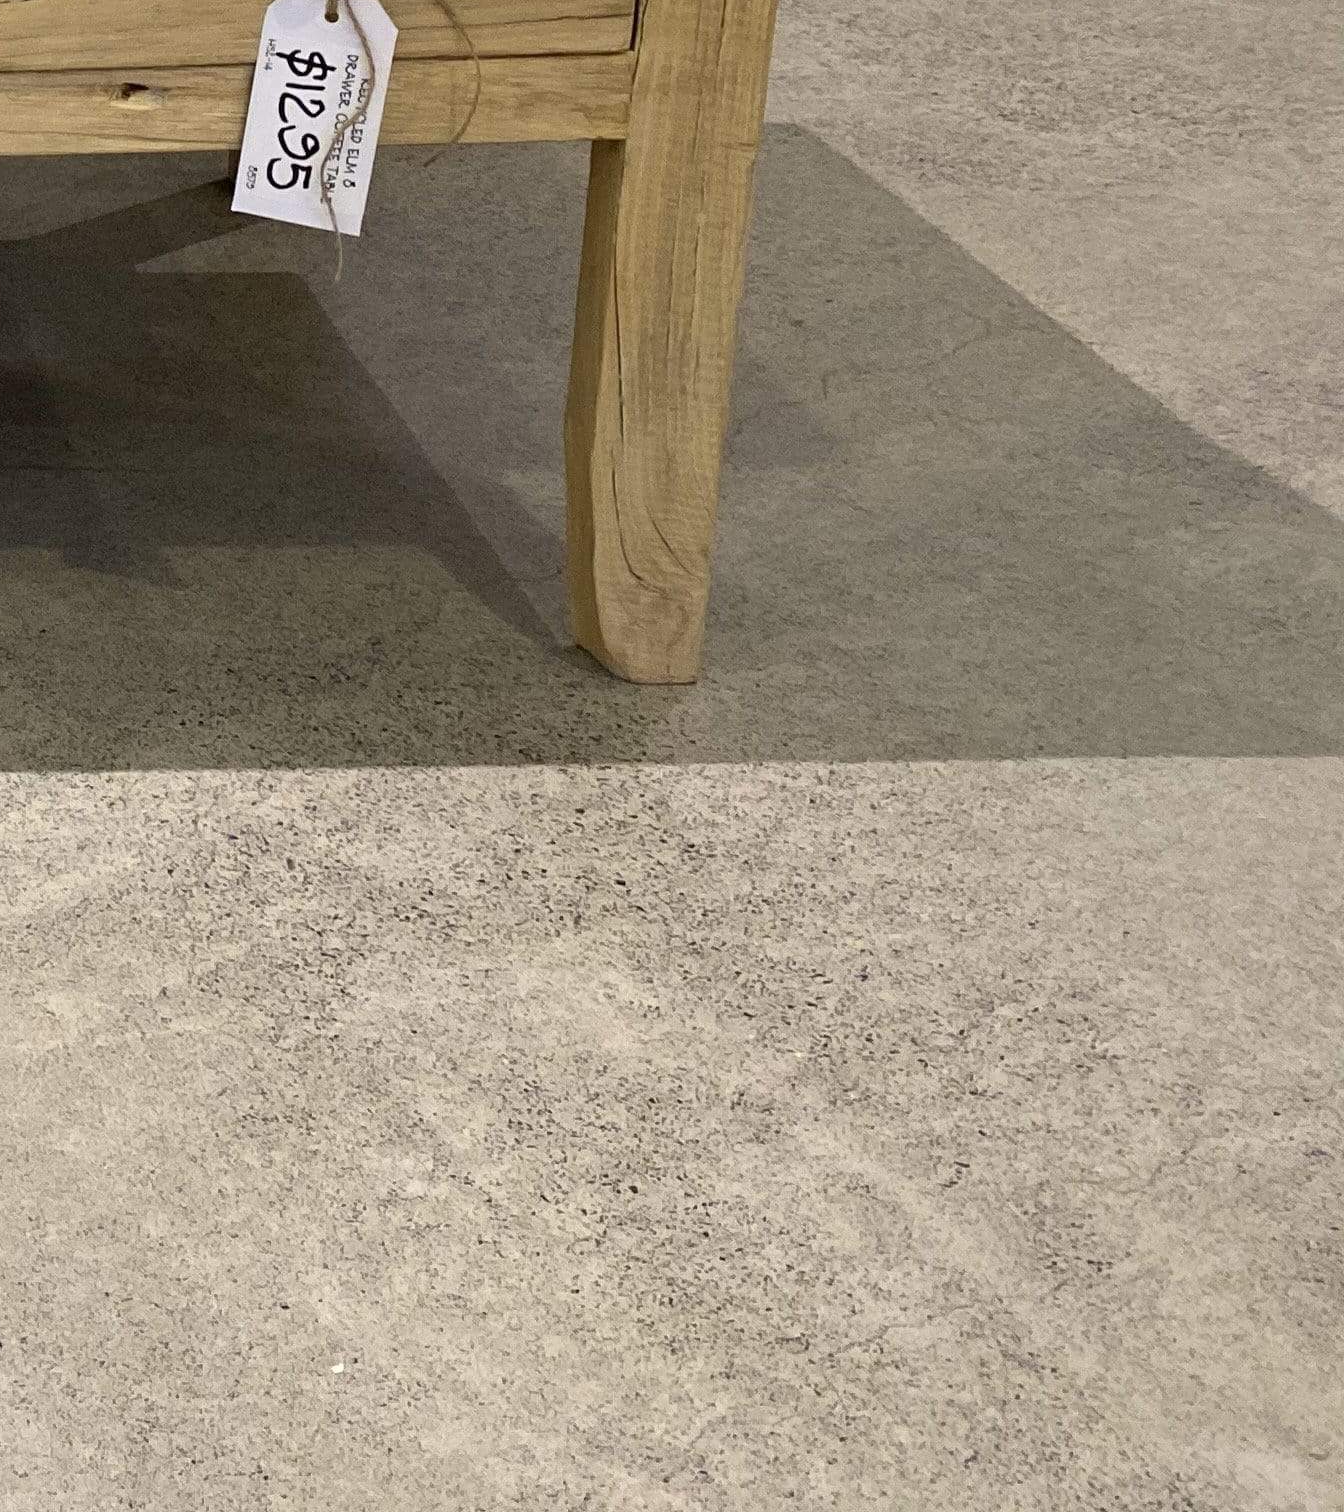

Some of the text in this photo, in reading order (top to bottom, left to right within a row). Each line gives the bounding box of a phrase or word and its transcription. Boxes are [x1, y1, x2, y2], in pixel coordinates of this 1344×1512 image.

[338, 55, 359, 109] DRAWER
[266, 49, 336, 190] $1295
[344, 149, 359, 174] ELM
